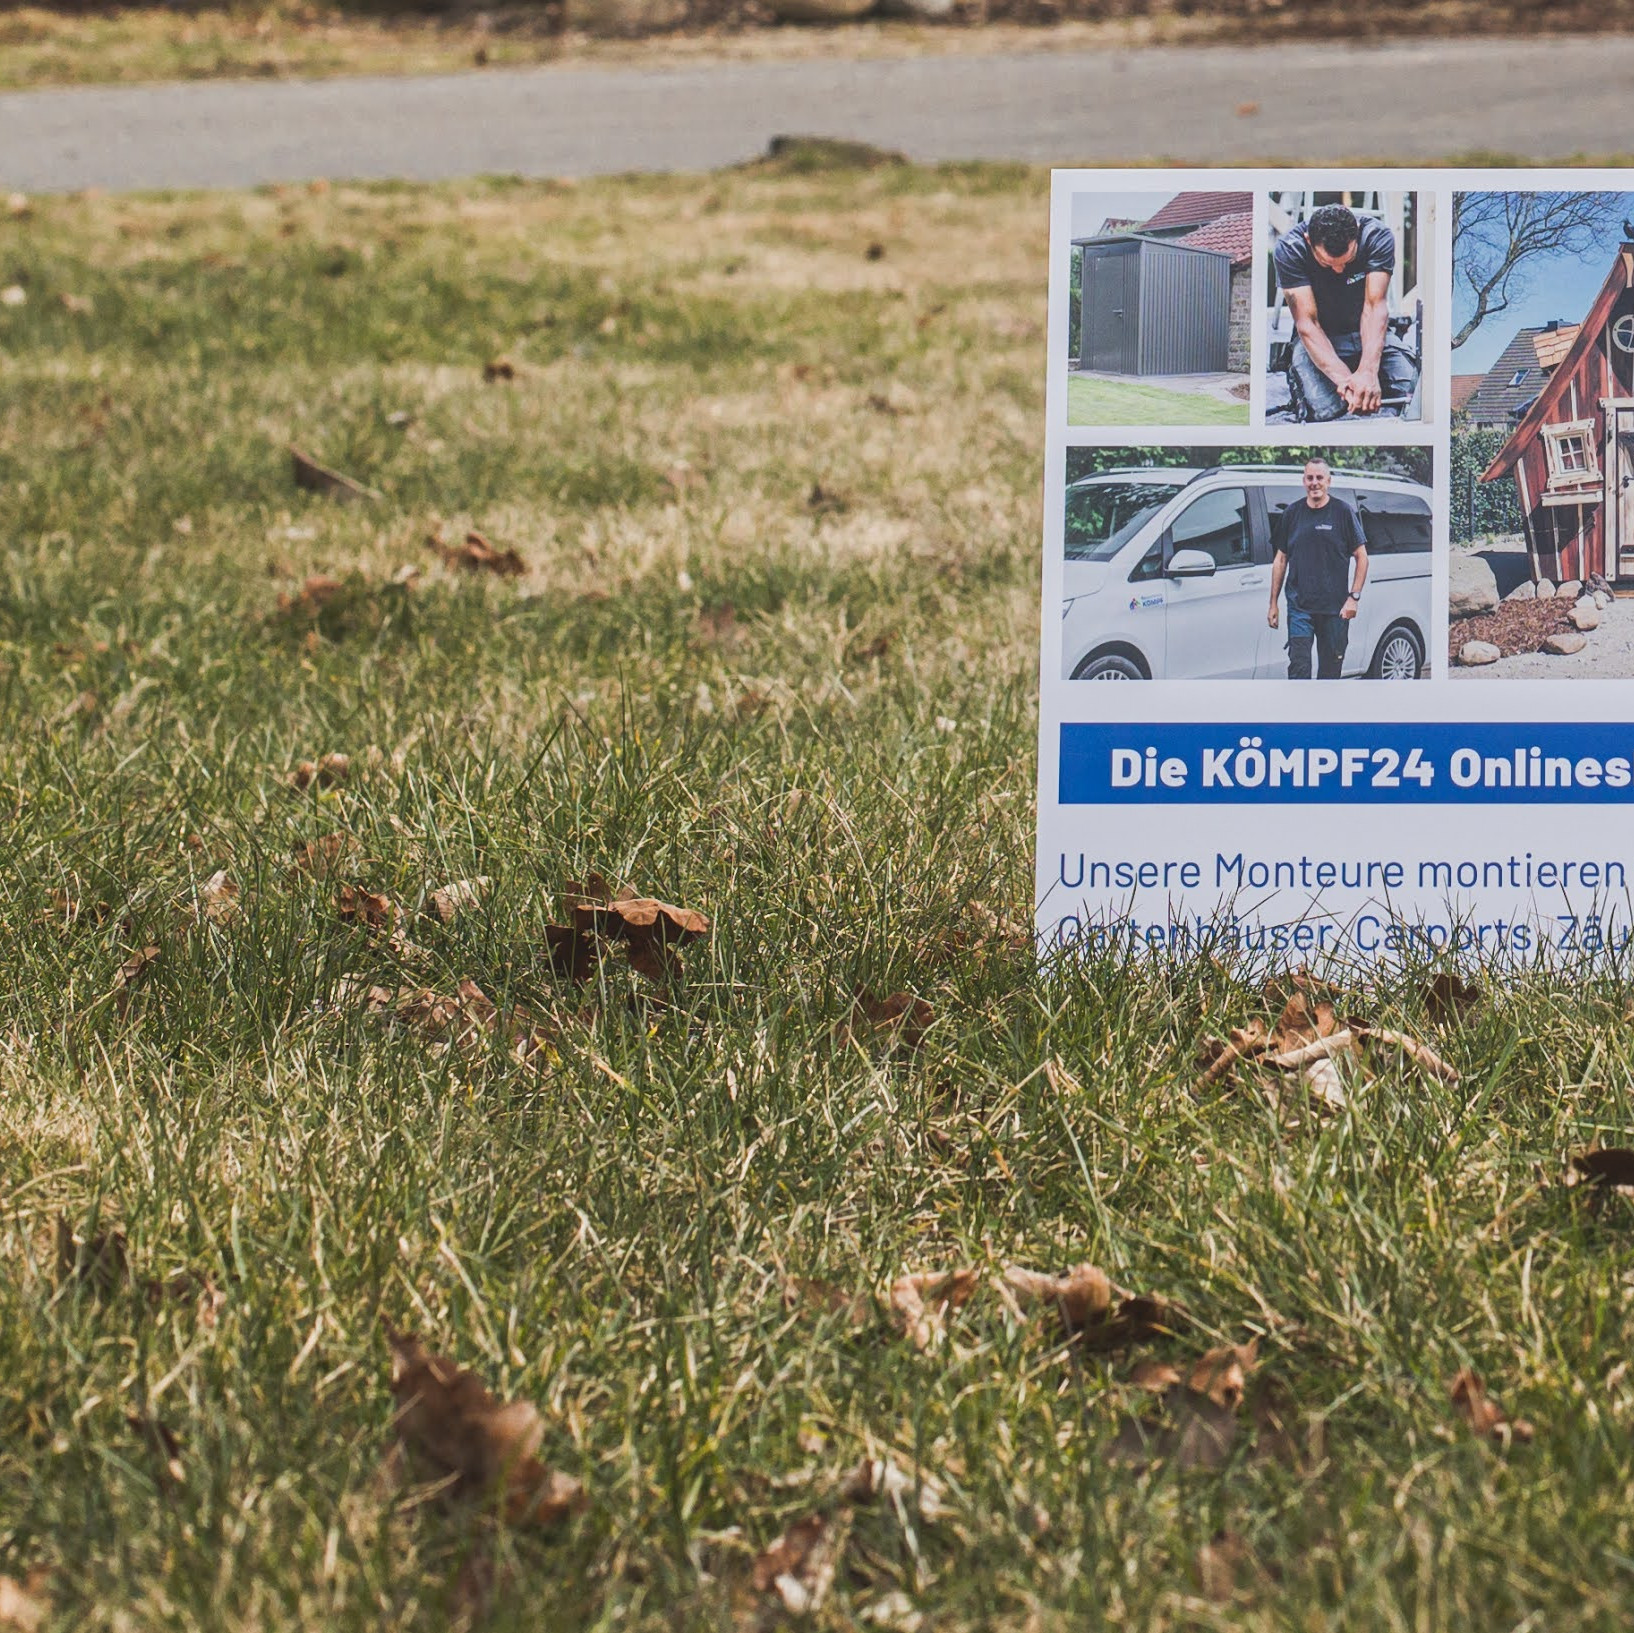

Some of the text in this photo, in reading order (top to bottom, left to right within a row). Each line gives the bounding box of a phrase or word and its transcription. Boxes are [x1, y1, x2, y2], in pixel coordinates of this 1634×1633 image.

[1111, 746, 1188, 787] Die
[1202, 736, 1435, 788] KÖMPF24
[1060, 853, 1201, 888] Unsere
[1216, 853, 1405, 888] Monteure
[1418, 852, 1625, 888] montieren
